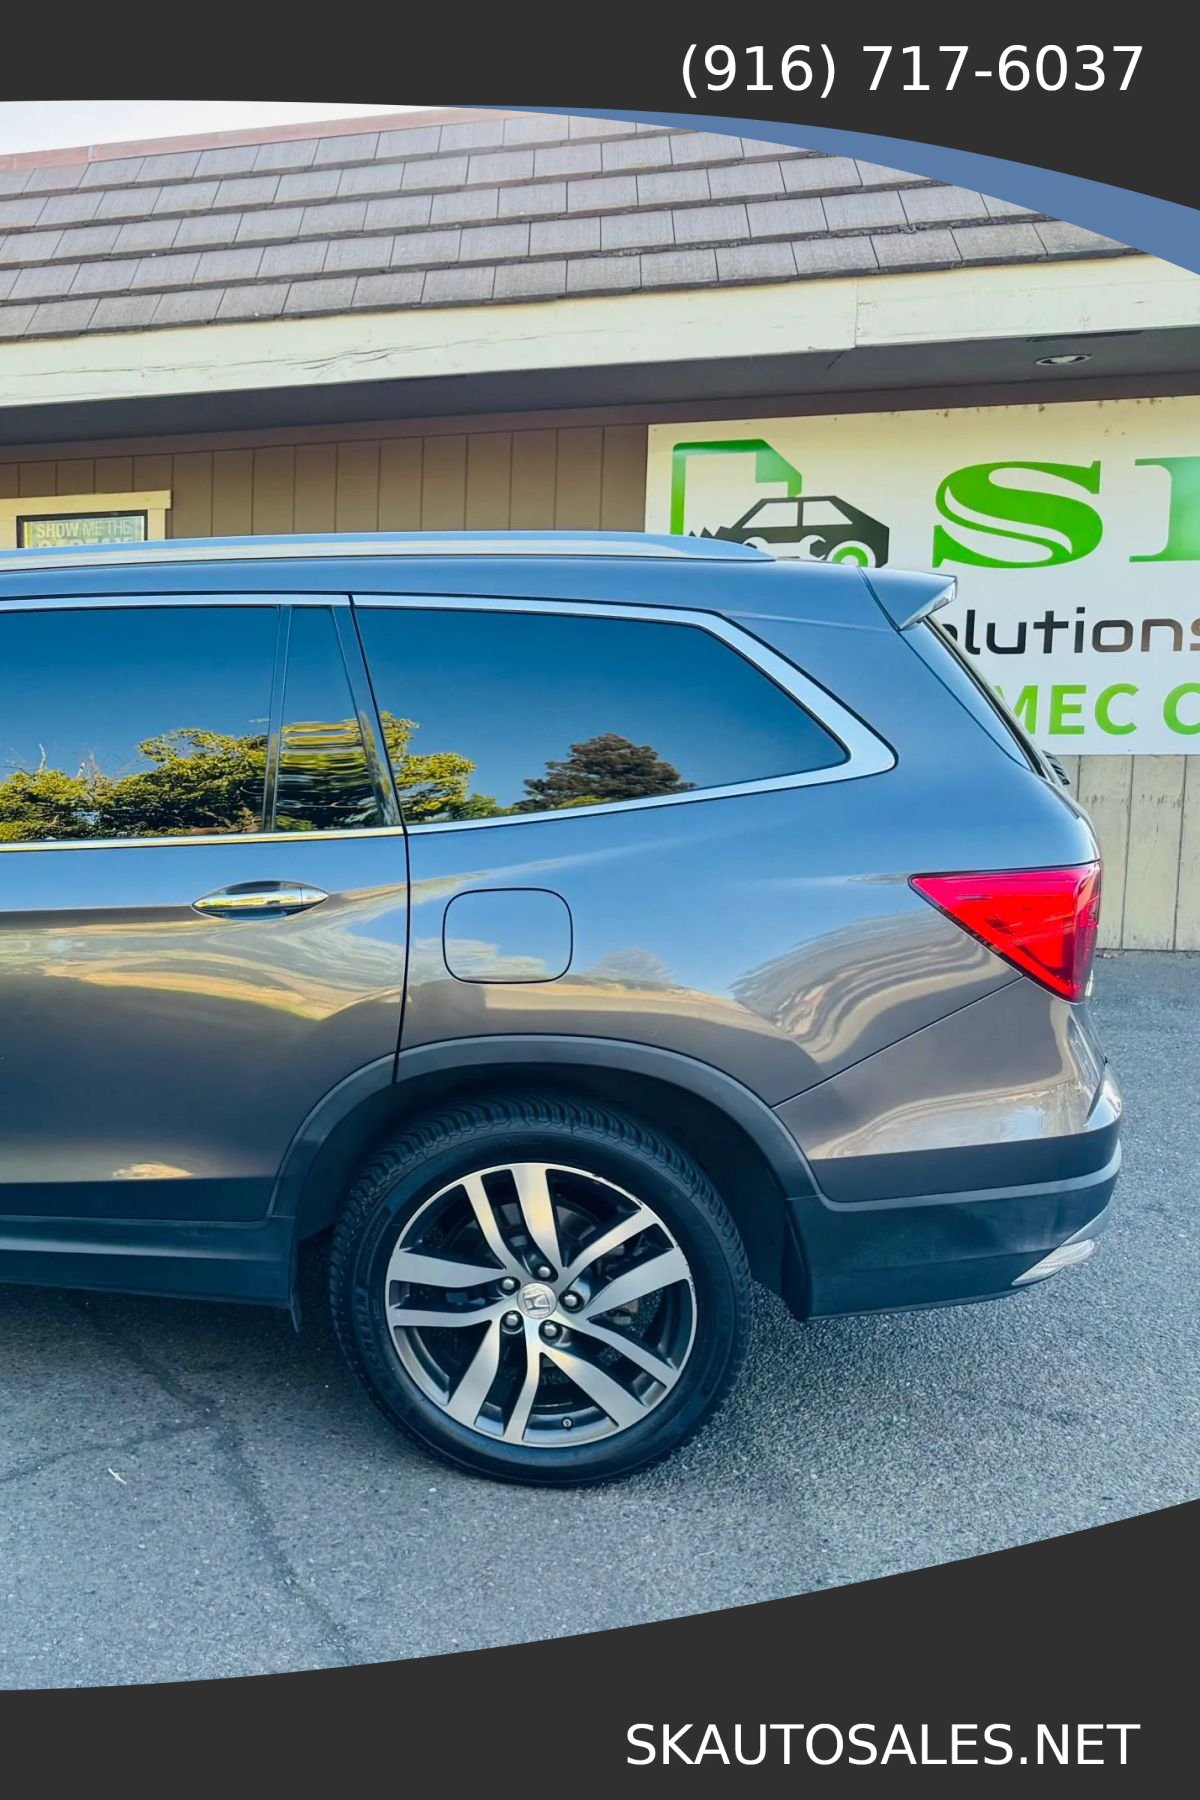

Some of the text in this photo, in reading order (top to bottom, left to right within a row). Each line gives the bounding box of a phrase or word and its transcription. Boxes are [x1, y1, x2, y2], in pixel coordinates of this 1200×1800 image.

[36, 519, 131, 538] SHOW ME THE
[933, 456, 1200, 569] S
